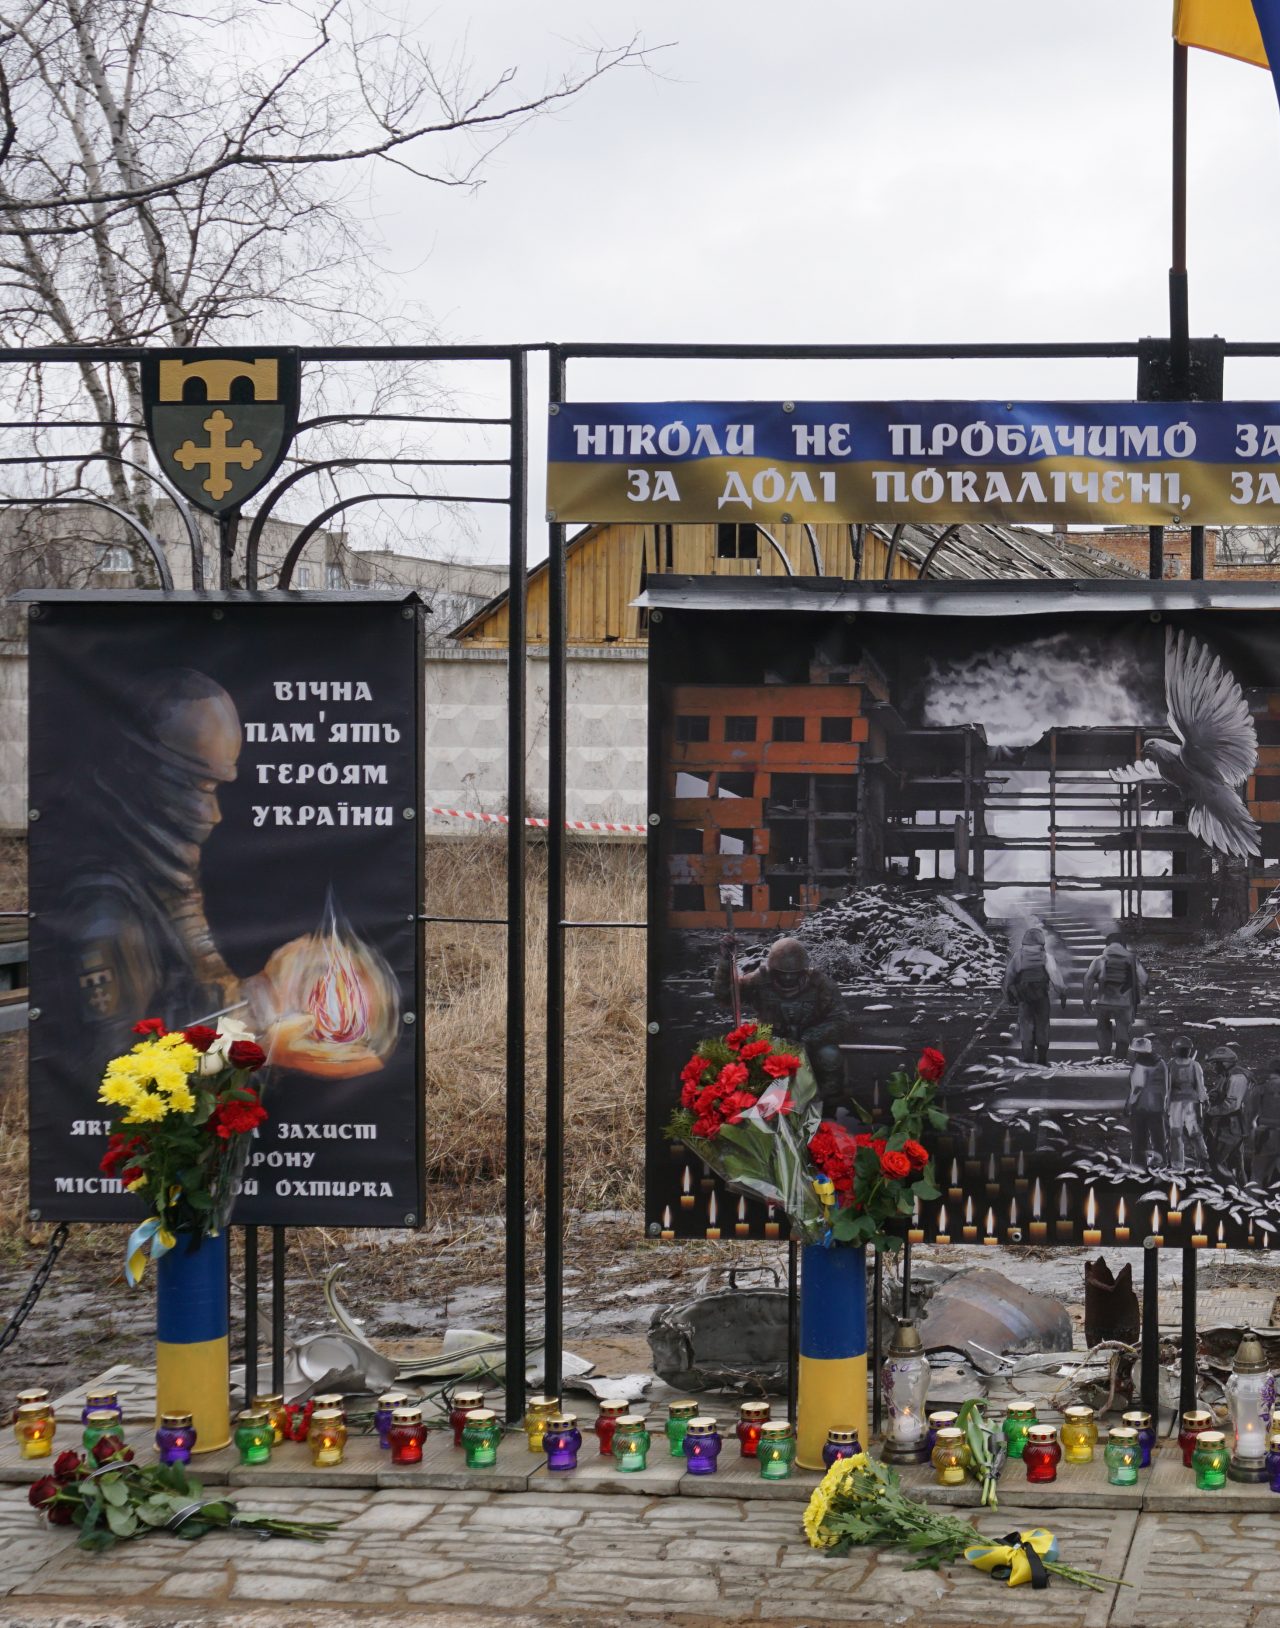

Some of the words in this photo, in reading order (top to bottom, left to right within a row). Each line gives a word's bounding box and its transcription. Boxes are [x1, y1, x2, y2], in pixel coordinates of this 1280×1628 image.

[574, 421, 755, 457] НІКОЛИ
[792, 423, 851, 456] НЕ
[889, 421, 1197, 459] ПРОБАЧИМО
[627, 469, 681, 502] ЗА
[718, 467, 836, 510] ДОЛІ
[872, 467, 1191, 510] ПОКАЛІЧЕНІ,
[273, 681, 373, 701] ВІЧНА
[244, 710, 401, 744] ПАМ'ЯТЬ
[256, 762, 388, 785] ГЕРОЯМ
[251, 802, 393, 827] УКРАЇНИ
[277, 1123, 377, 1140] ЗАХИСТ
[54, 1176, 136, 1195] МІСТ
[275, 1179, 394, 1198] ОХТИРКА
